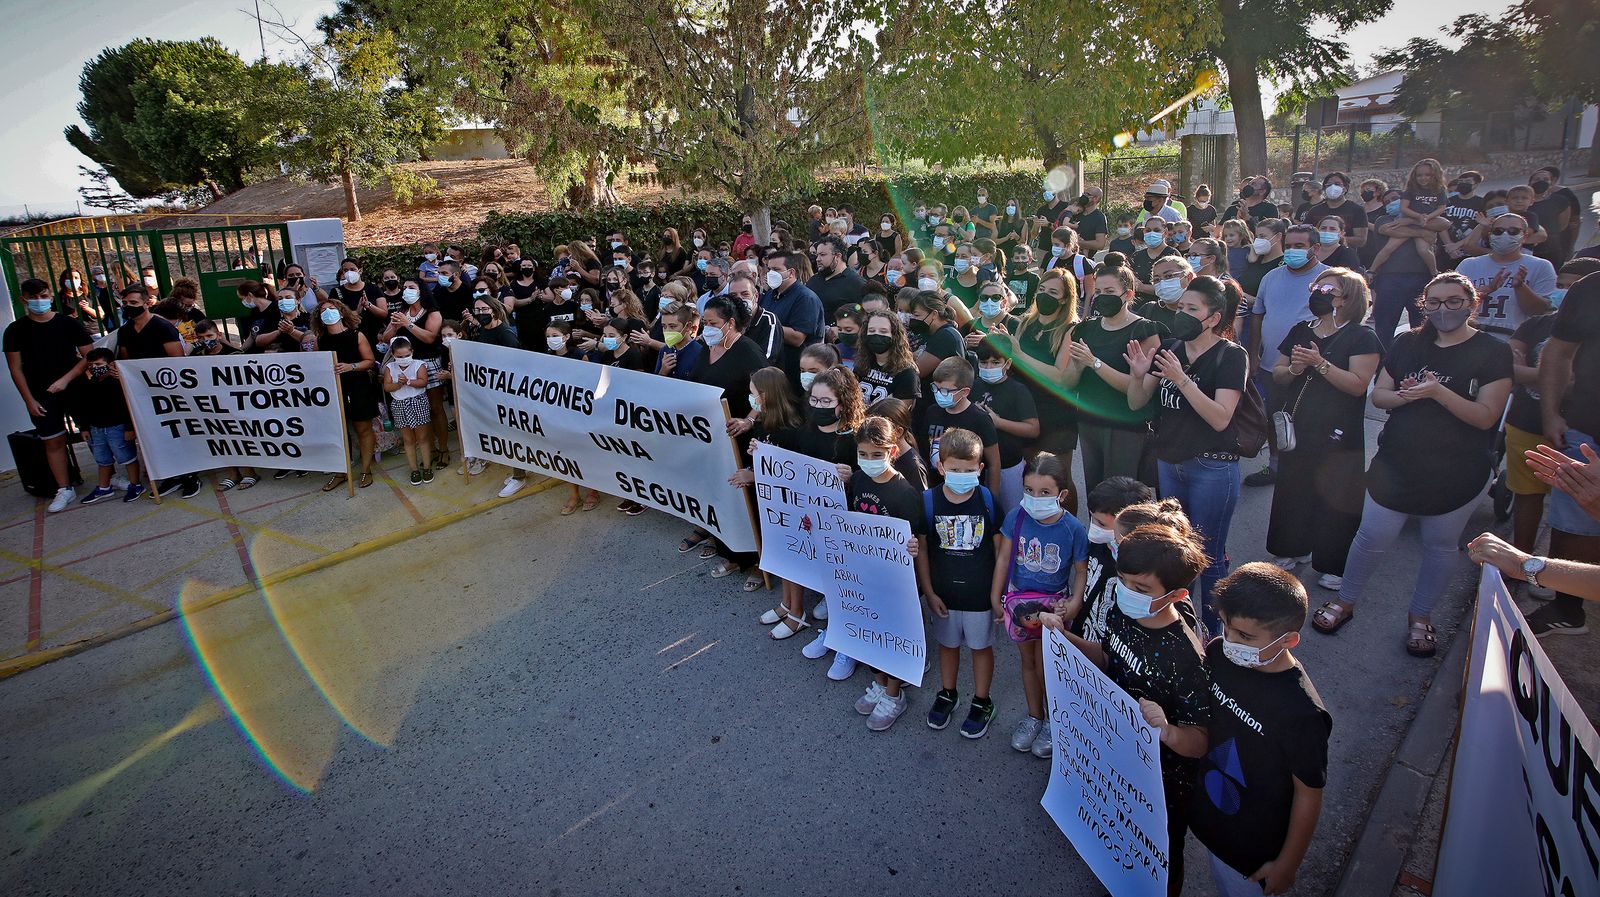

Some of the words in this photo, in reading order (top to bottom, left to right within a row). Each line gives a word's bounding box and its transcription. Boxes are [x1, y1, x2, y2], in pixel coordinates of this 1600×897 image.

[141, 368, 198, 390] L@S
[213, 360, 305, 386] NIÑ@S
[152, 393, 191, 415] DE
[193, 394, 230, 414] EL
[230, 386, 331, 411] TORNO
[464, 361, 594, 416] INSTALACIONES
[615, 398, 712, 443] DIGNAS
[161, 417, 304, 439] TENEMOS
[497, 404, 545, 437] PARA
[588, 432, 654, 461] UNA
[207, 438, 302, 458] MIEDO
[760, 455, 796, 480] NOS
[478, 433, 583, 480] EDUCACIÓN
[615, 471, 722, 533] SEGURA
[766, 508, 791, 527] DE
[832, 515, 905, 545] PRIORITARIO
[825, 537, 839, 550] ES
[842, 540, 910, 566] PRIORITARIO
[834, 569, 863, 586] ABRIL
[838, 584, 865, 601] JUNIO
[841, 601, 879, 620] AGOSTO
[1109, 633, 1145, 676] ORIGINAL
[1049, 632, 1071, 668] SR
[1073, 655, 1152, 744] DELEGADO
[1136, 740, 1154, 770] DE
[1054, 660, 1124, 742] PROVINCIAL
[1211, 682, 1262, 733] PlayStation
[1058, 730, 1072, 747] ES
[1075, 748, 1090, 768] UN
[1092, 766, 1132, 814] TIEMPO
[1107, 763, 1153, 813] TIEMPO
[1058, 762, 1072, 786] DE
[1129, 839, 1159, 881] PARA
